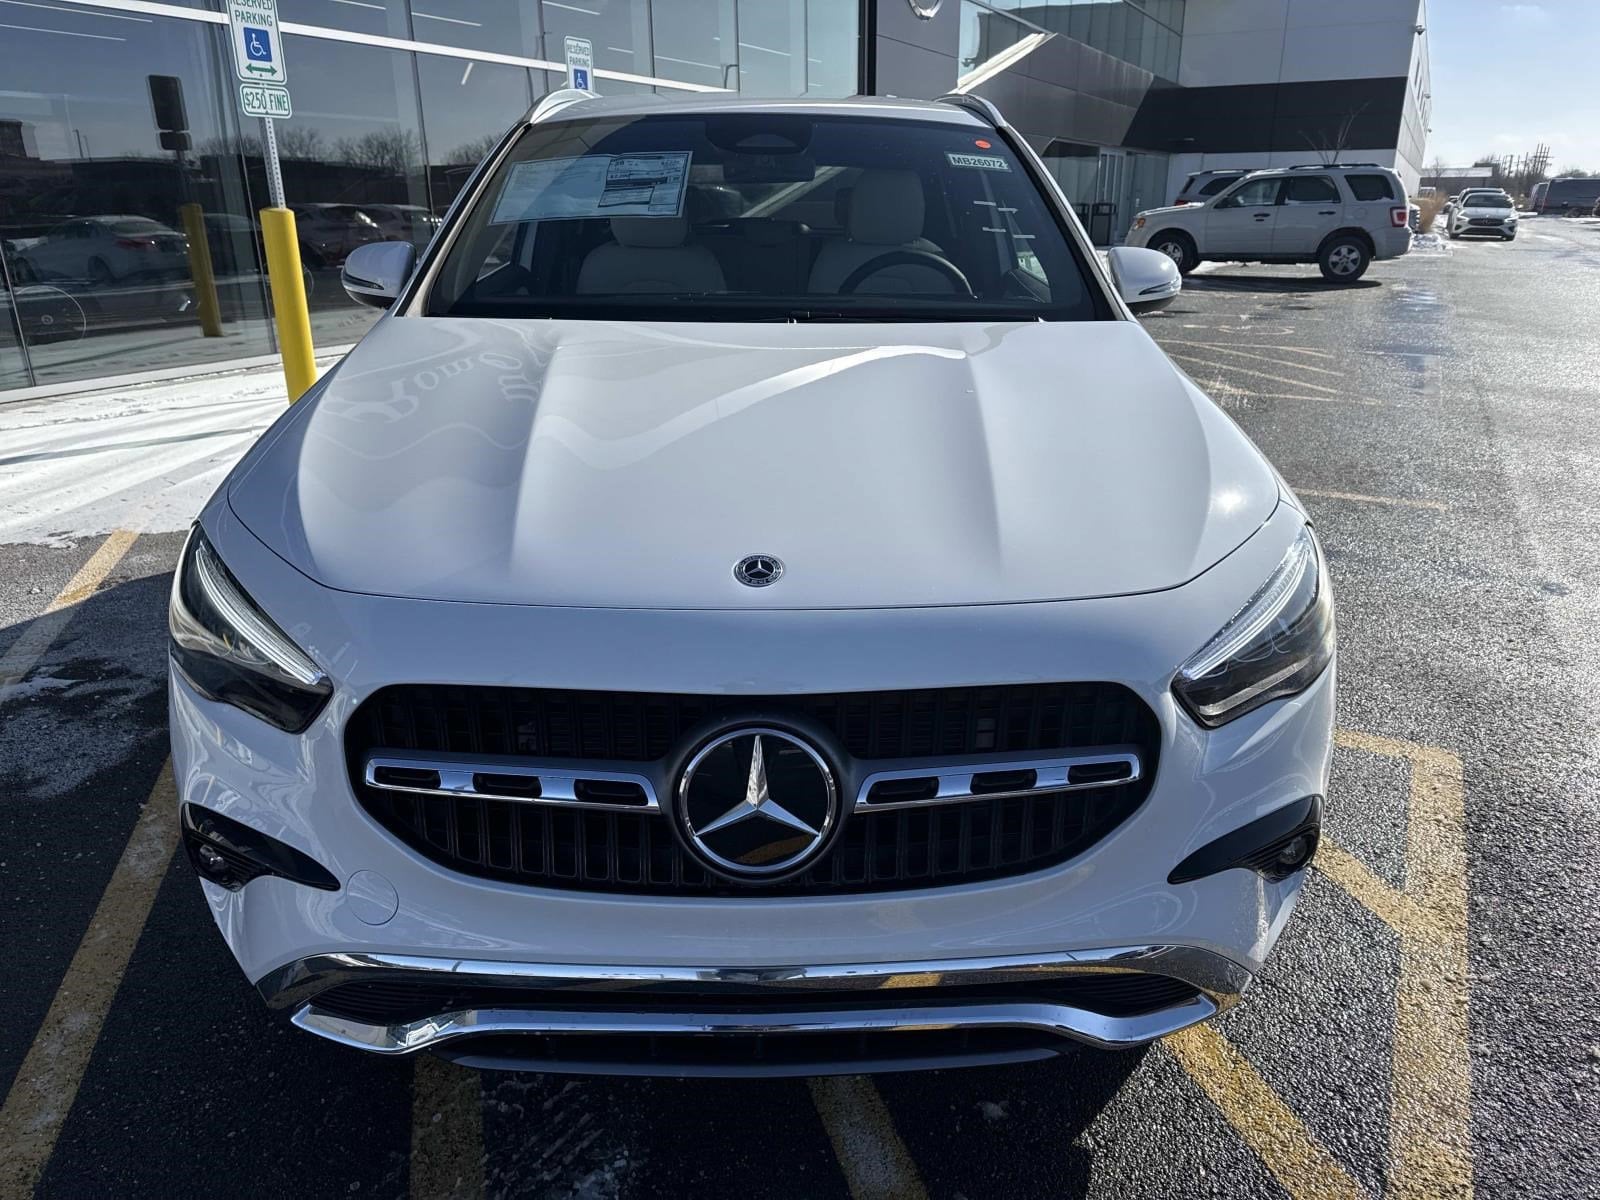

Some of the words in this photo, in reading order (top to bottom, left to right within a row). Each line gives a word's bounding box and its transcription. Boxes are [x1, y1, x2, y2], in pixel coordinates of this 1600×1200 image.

[235, 9, 273, 27] PARKING
[569, 55, 590, 68] PARKING
[245, 91, 267, 110] $250
[269, 93, 288, 111] FINE
[951, 156, 1004, 168] MB26072
